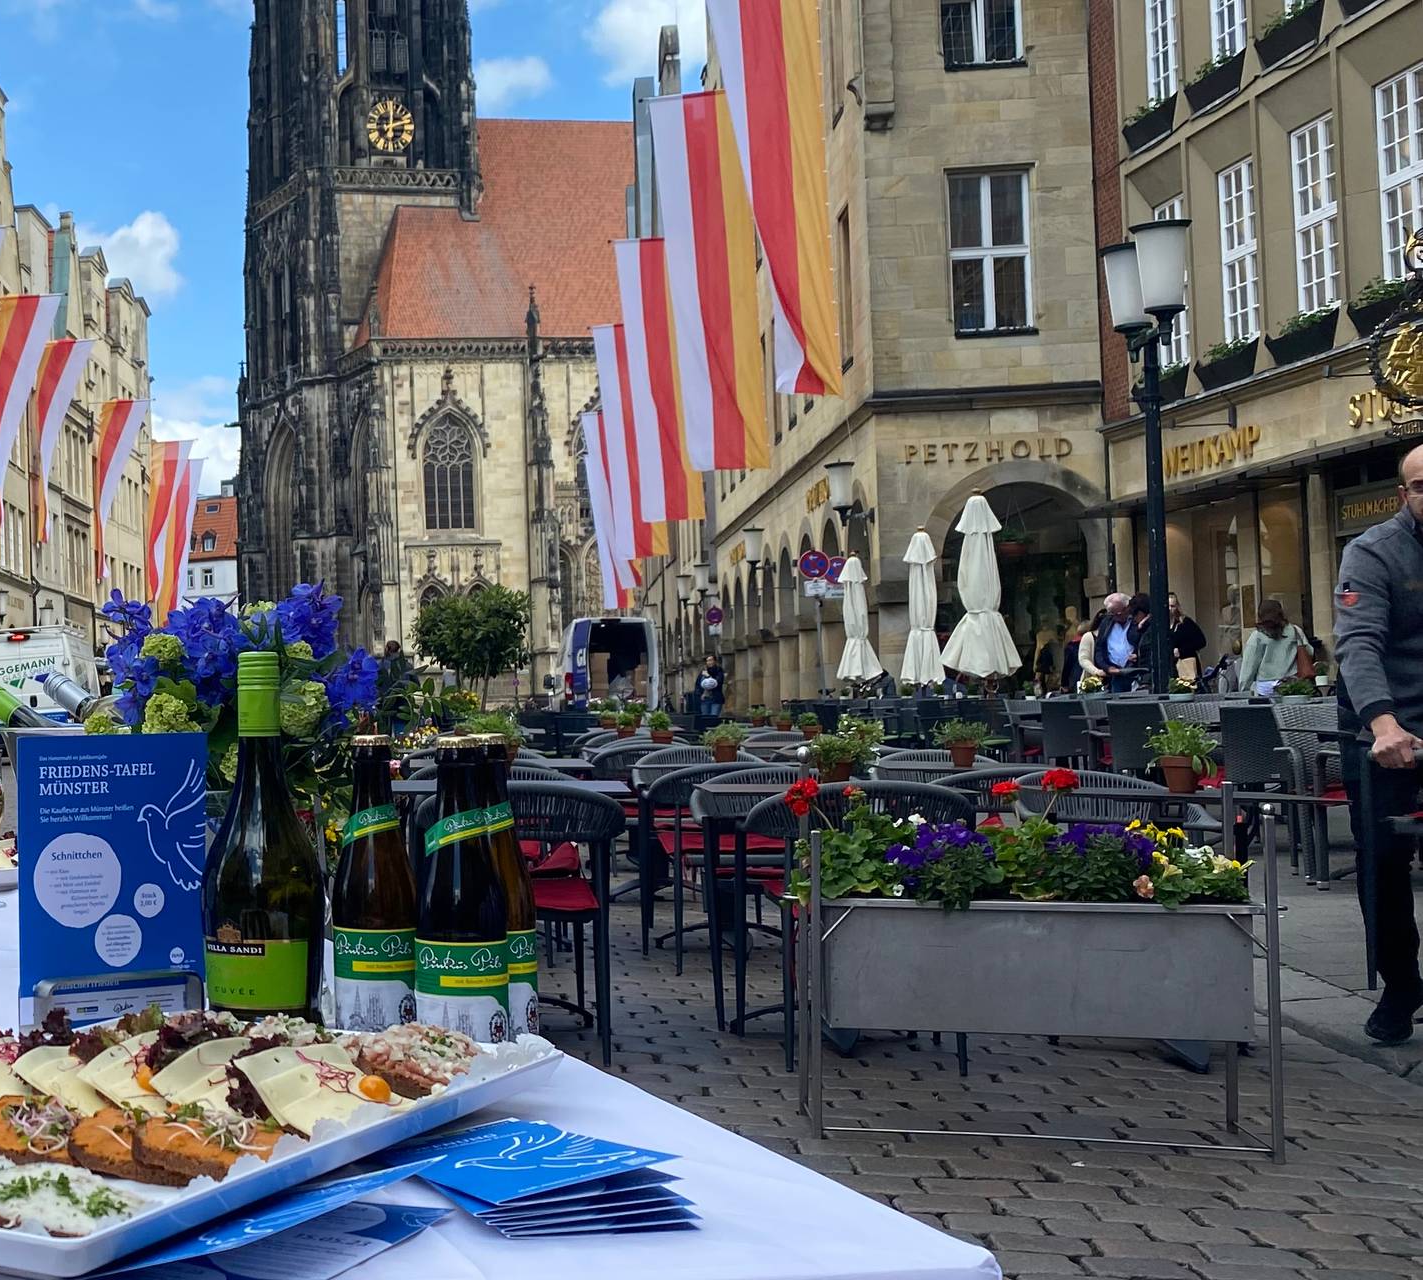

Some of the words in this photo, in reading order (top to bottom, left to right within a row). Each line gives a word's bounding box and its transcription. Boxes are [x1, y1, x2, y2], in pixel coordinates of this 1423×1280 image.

[904, 438, 1074, 465] PETZHOLD
[2, 672, 22, 682] GLAS
[39, 763, 156, 779] FRIEDENS-TAFEL
[38, 779, 109, 796] MÜNSTER
[51, 806, 79, 814] Kaufleute
[39, 815, 49, 823] Sie
[50, 814, 73, 823] herzlich
[51, 850, 103, 861] Schnittchen
[206, 943, 228, 953] VILLA
[229, 944, 263, 955] SANDI
[334, 932, 379, 957] Pinkus
[381, 934, 412, 958] Pils
[418, 946, 468, 971] Pinkus
[470, 947, 503, 973] Pils
